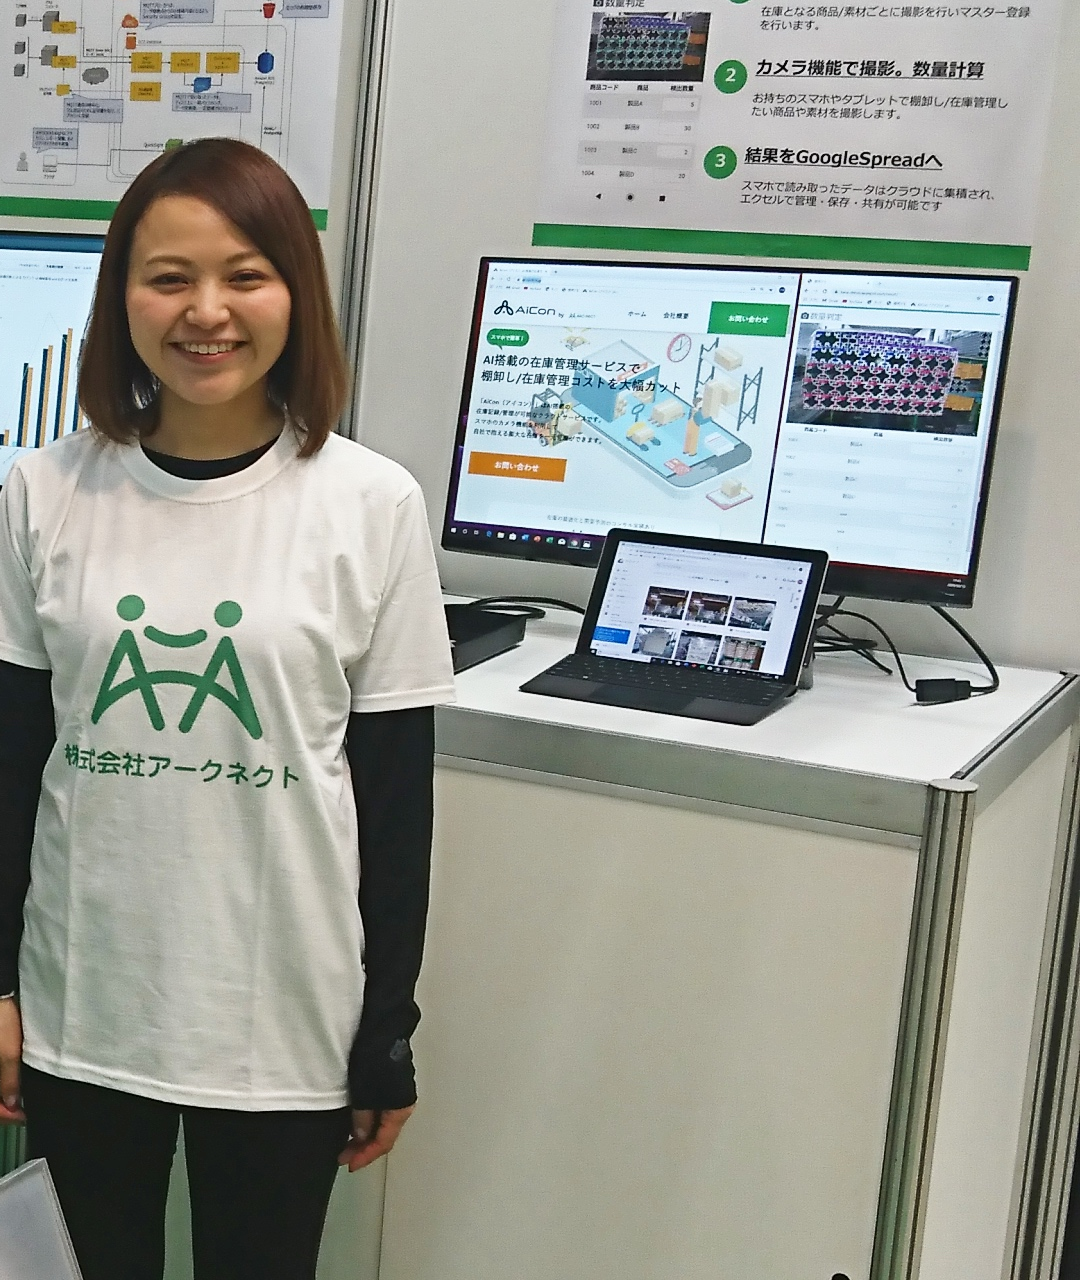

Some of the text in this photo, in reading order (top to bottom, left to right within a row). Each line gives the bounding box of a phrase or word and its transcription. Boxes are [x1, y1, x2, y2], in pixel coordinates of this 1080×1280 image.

[760, 20, 819, 31] を行います。
[725, 68, 736, 82] 2
[756, 59, 985, 79] カメラ機能で撮影。数量計算
[751, 107, 901, 120] たい商品や素材を撮影します。
[715, 154, 726, 168] 3
[744, 147, 943, 168] 結果をGoogleSpreadへ
[740, 193, 942, 211] エクセルで管理・保存・共有が可能です
[483, 354, 640, 374] AI搭載の在庫管理サービスで
[481, 369, 681, 394] 棚卸し/在庫管理コストを大幅カット
[64, 743, 299, 789] 株式会社アークネクト
